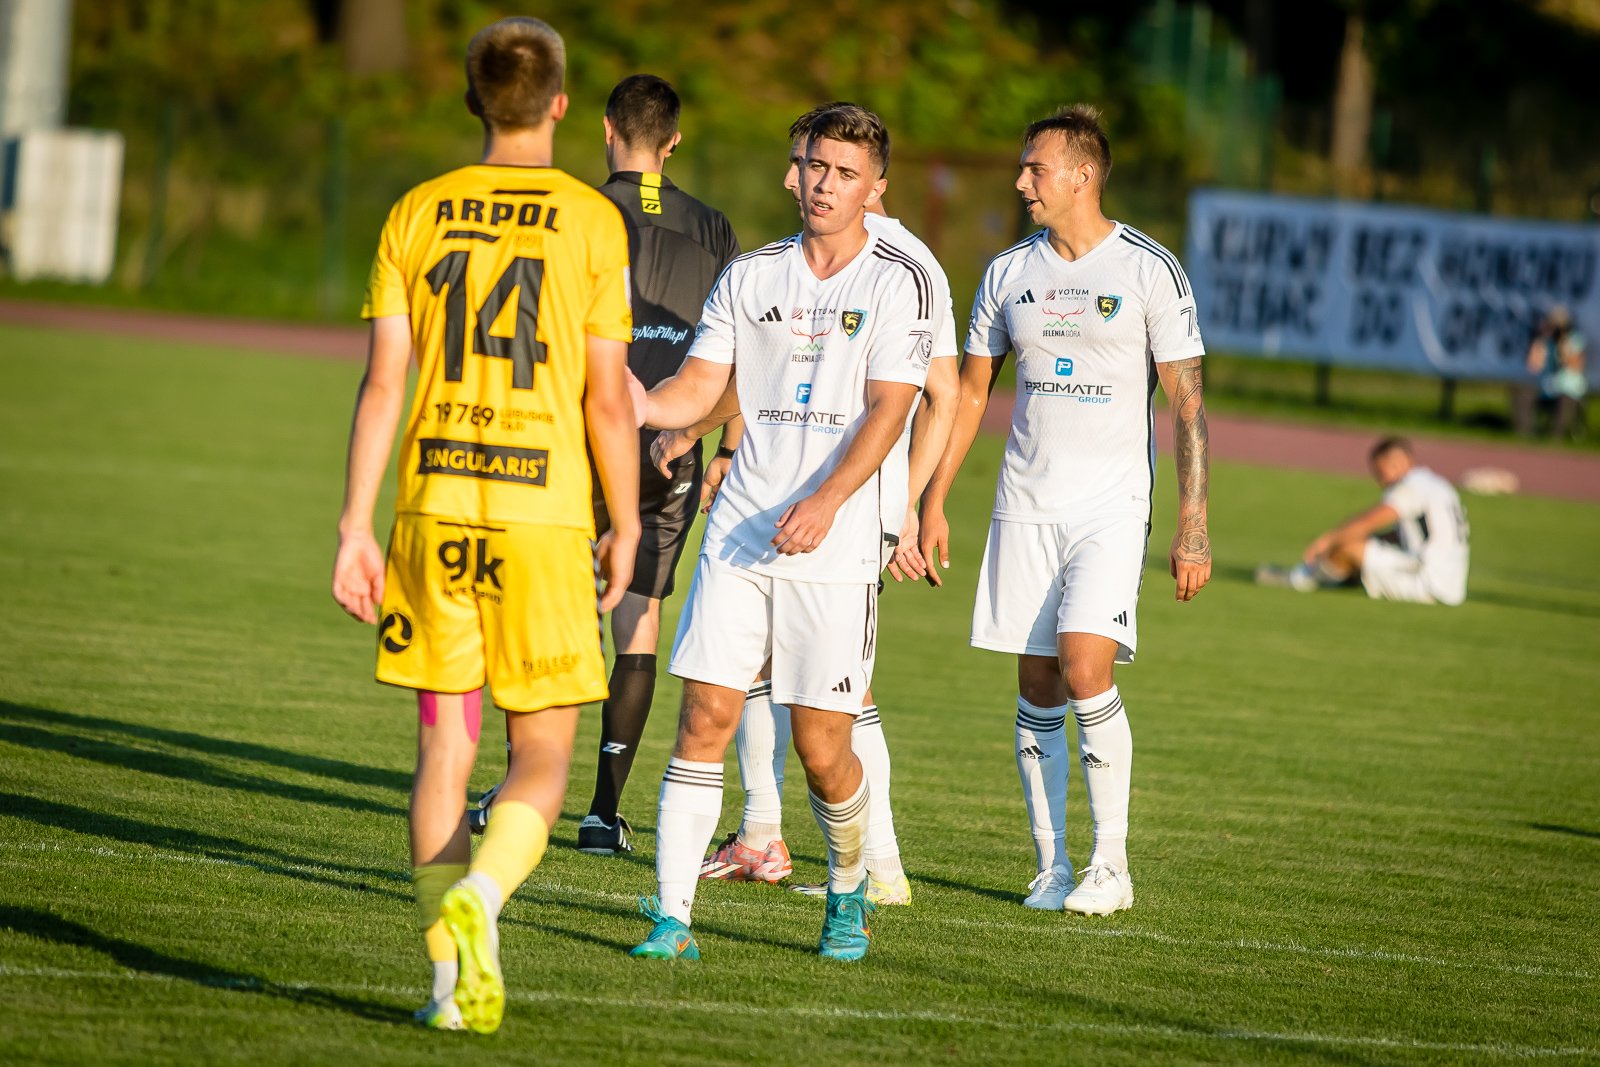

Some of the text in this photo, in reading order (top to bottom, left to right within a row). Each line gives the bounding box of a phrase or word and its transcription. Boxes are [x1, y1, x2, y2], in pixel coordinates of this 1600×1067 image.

[436, 198, 559, 233] ARPOL
[1058, 288, 1089, 296] VOTUM
[425, 251, 548, 390] 14
[1025, 381, 1113, 396] PROMATIC
[1078, 396, 1112, 405] GROUP
[757, 410, 846, 426] PROMATIC
[811, 425, 844, 435] GROUP
[438, 537, 504, 590] gk
